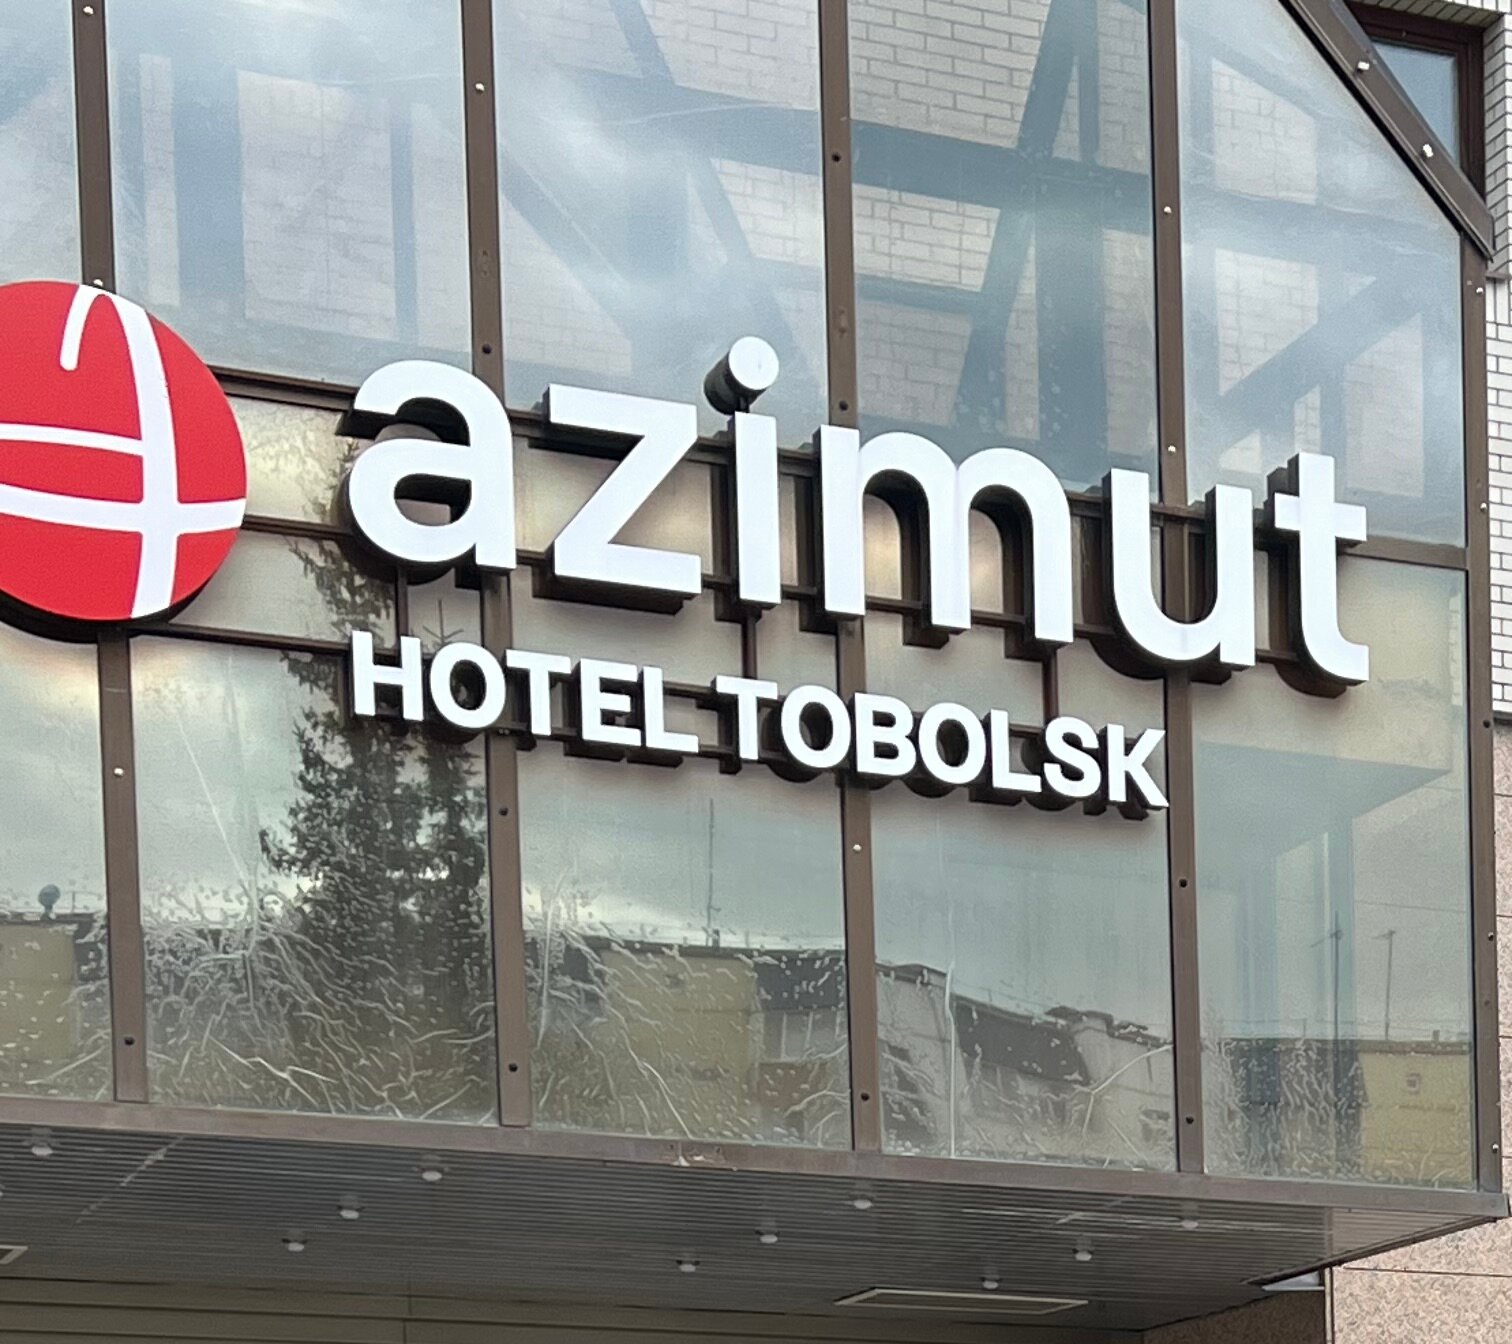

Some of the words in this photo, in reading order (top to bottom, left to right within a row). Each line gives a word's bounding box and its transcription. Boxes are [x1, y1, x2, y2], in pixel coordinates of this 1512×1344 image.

[349, 336, 1371, 682] azimut
[351, 630, 699, 753] HOTEL
[715, 674, 1169, 807] TOBOLSK
